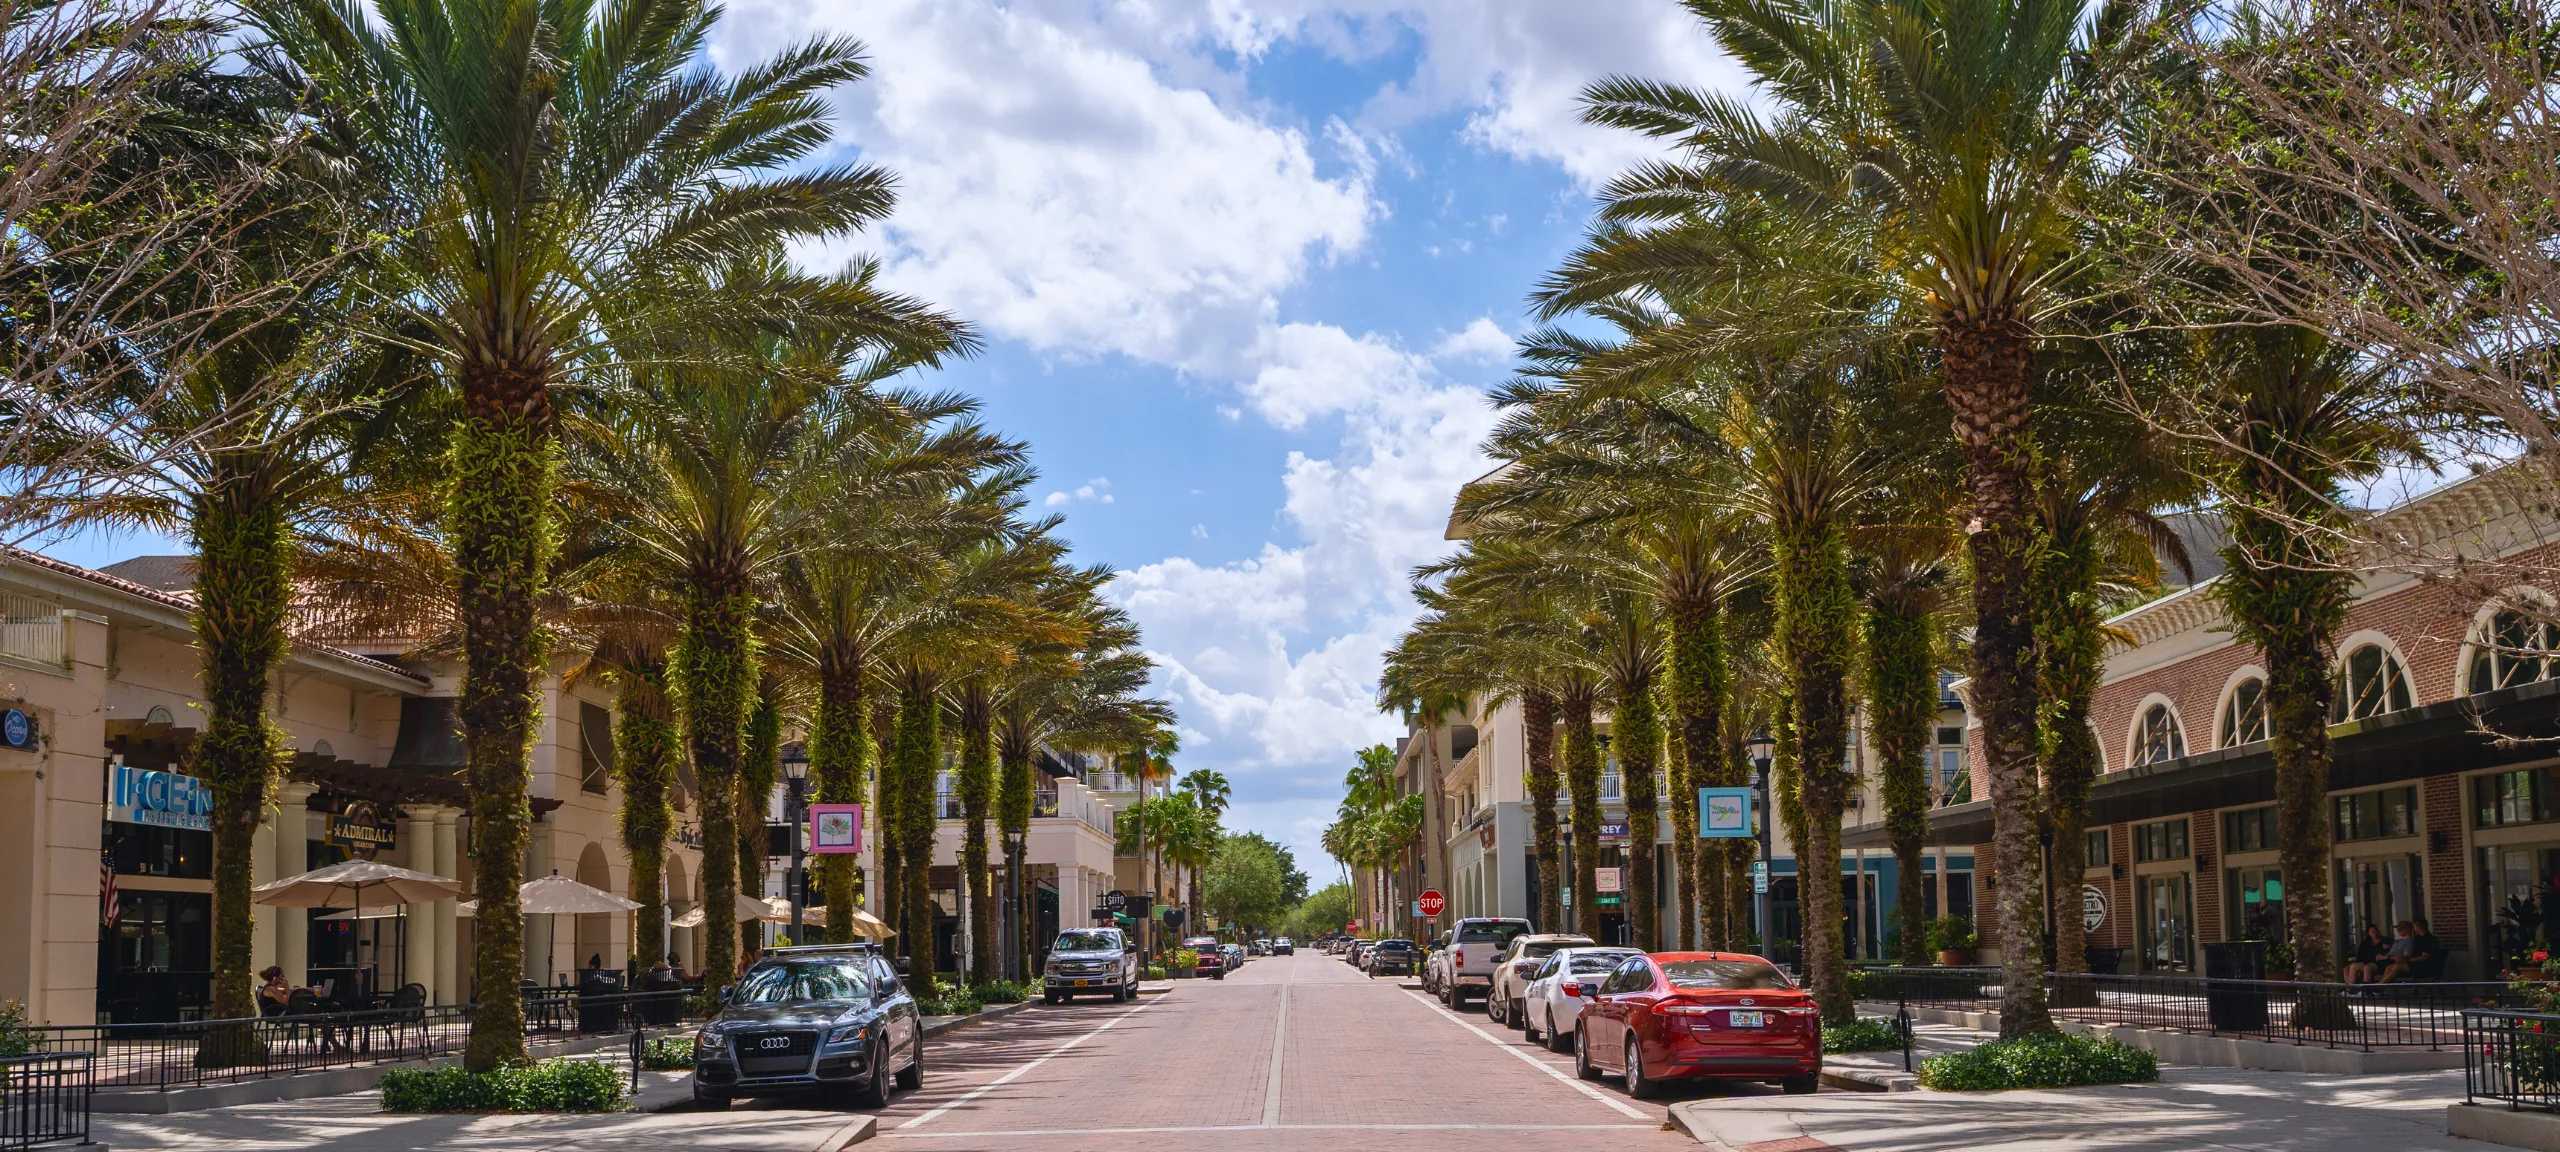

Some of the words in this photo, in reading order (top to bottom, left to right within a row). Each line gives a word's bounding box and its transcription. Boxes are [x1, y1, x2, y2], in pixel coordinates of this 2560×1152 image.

[142, 809, 177, 825] ROLLED
[176, 813, 191, 827] ICE
[191, 815, 213, 829] CRE
[341, 823, 388, 843] ADMIRAL
[1108, 896, 1125, 905] SEITO
[1420, 898, 1443, 909] STOP
